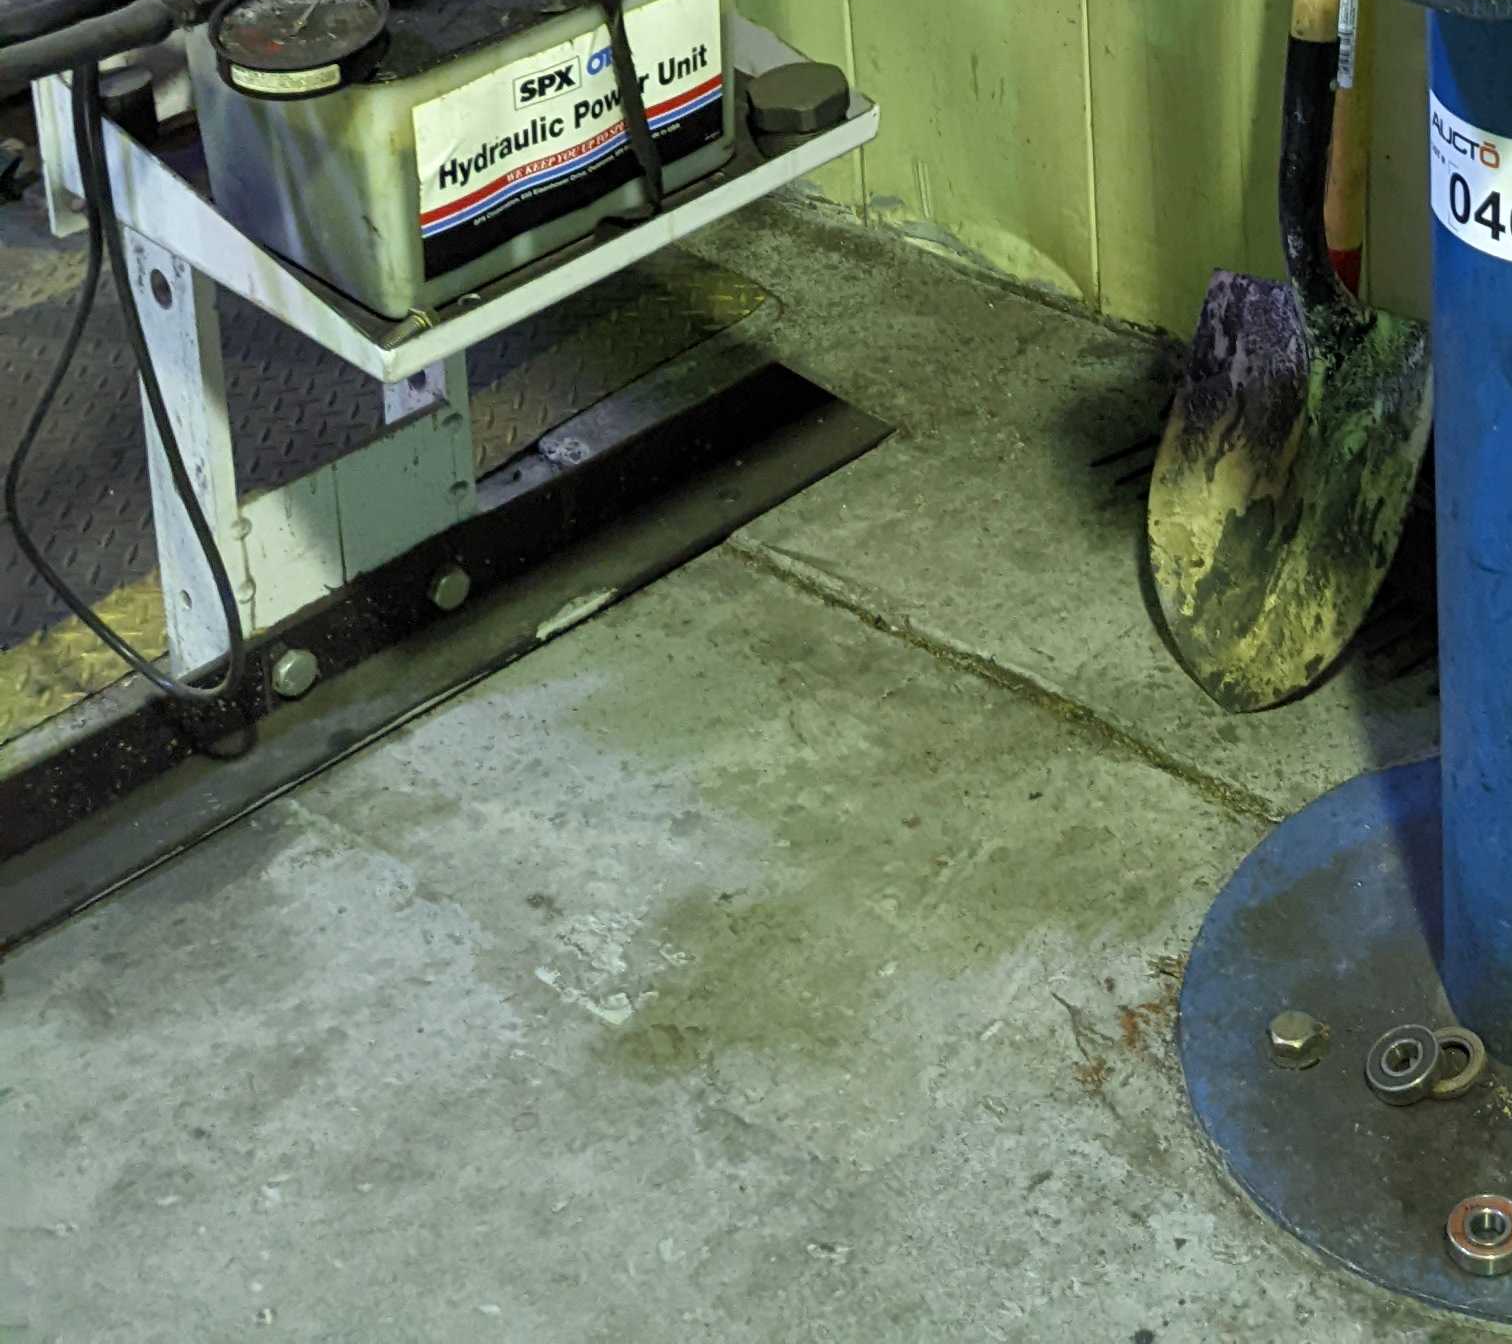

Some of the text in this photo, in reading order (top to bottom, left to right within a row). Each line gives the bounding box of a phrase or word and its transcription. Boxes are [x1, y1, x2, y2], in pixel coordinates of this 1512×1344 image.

[438, 43, 708, 190] Hydraulic Powr Unit
[520, 64, 576, 103] SPX
